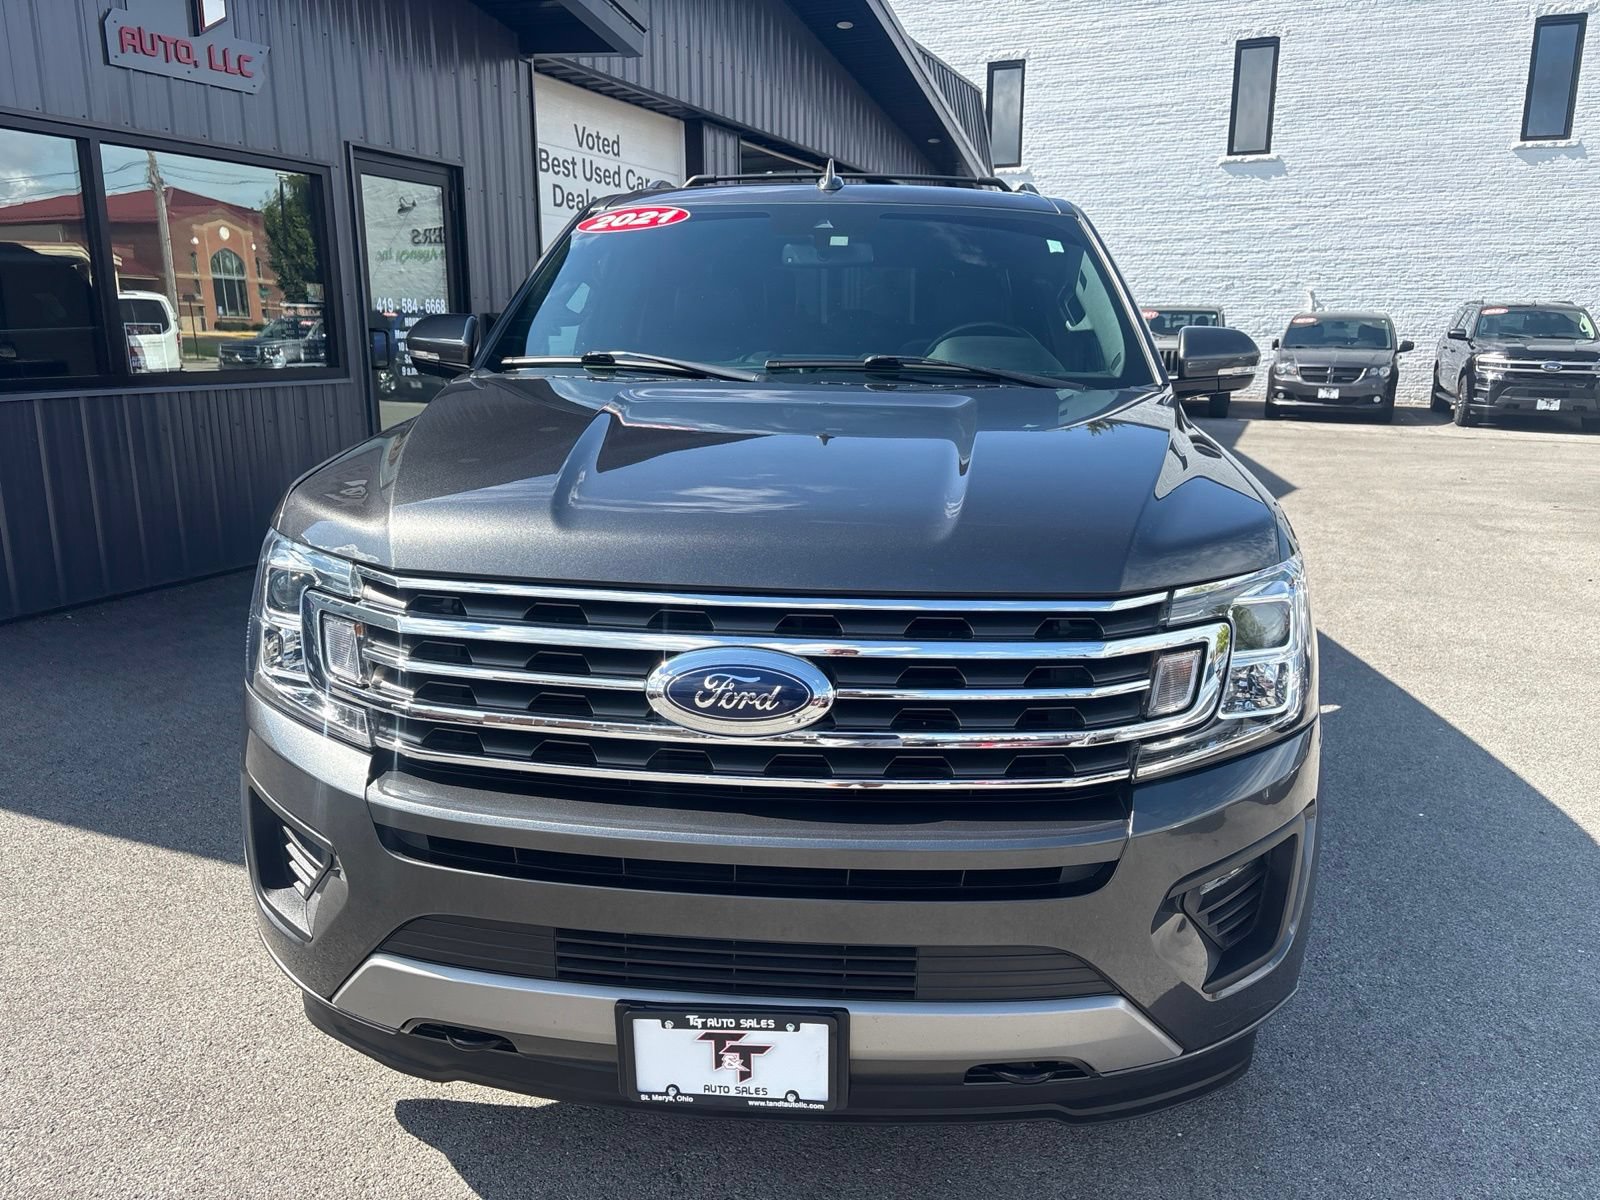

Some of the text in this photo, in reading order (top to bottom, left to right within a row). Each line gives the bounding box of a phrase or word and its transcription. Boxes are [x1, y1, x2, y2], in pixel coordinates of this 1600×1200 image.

[207, 43, 254, 78] LLC
[574, 123, 620, 157] Voted
[538, 147, 577, 180] Best
[582, 157, 621, 189] Used
[552, 183, 598, 211] Deal
[586, 209, 679, 230] 2021
[694, 673, 782, 710] Ford
[707, 1018, 735, 1028] AUTO
[740, 1018, 775, 1028] SALES
[676, 1095, 694, 1103] Ohio
[703, 1084, 768, 1096] AUTO SALES
